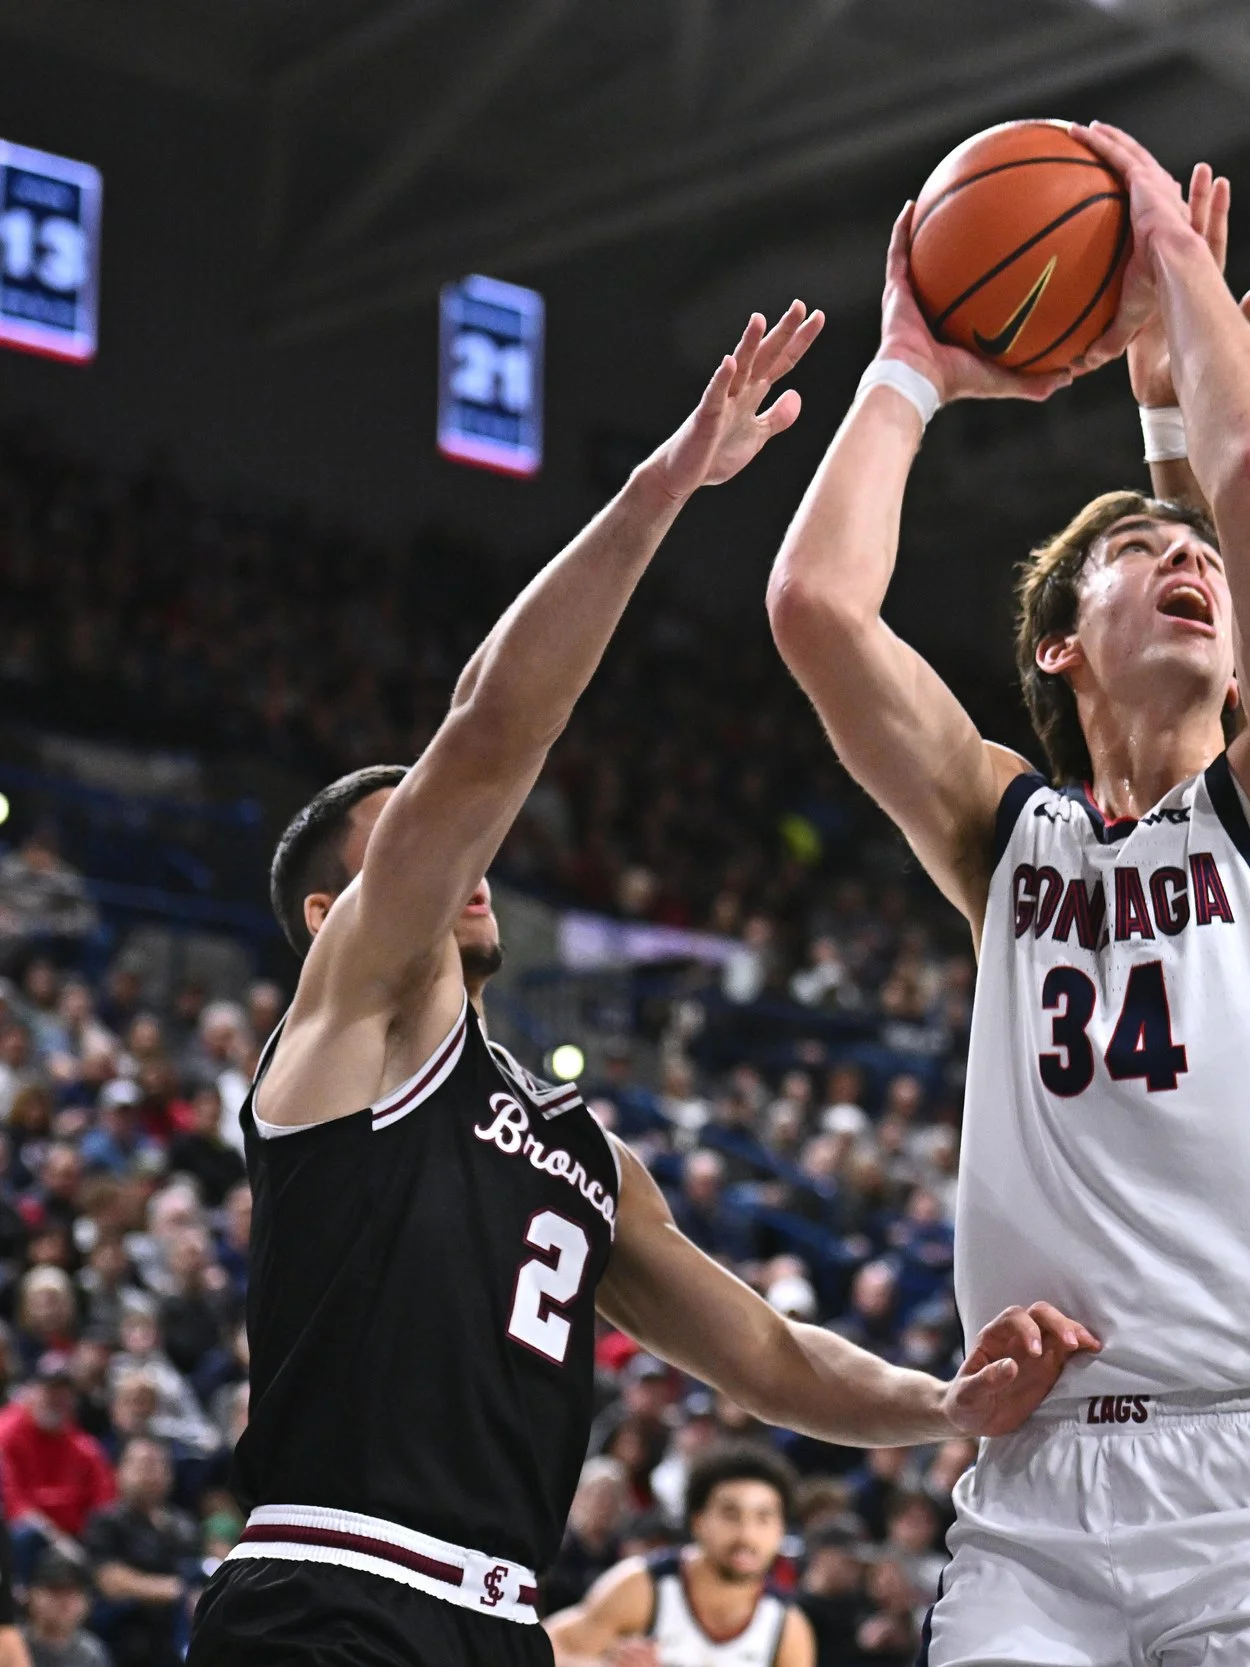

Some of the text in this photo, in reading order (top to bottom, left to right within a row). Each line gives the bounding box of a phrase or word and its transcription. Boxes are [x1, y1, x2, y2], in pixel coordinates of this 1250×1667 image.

[1013, 852, 1235, 950] GONAGA
[1039, 960, 1188, 1098] 34
[506, 1206, 590, 1368] 2
[1087, 1394, 1150, 1424] ZAGS
